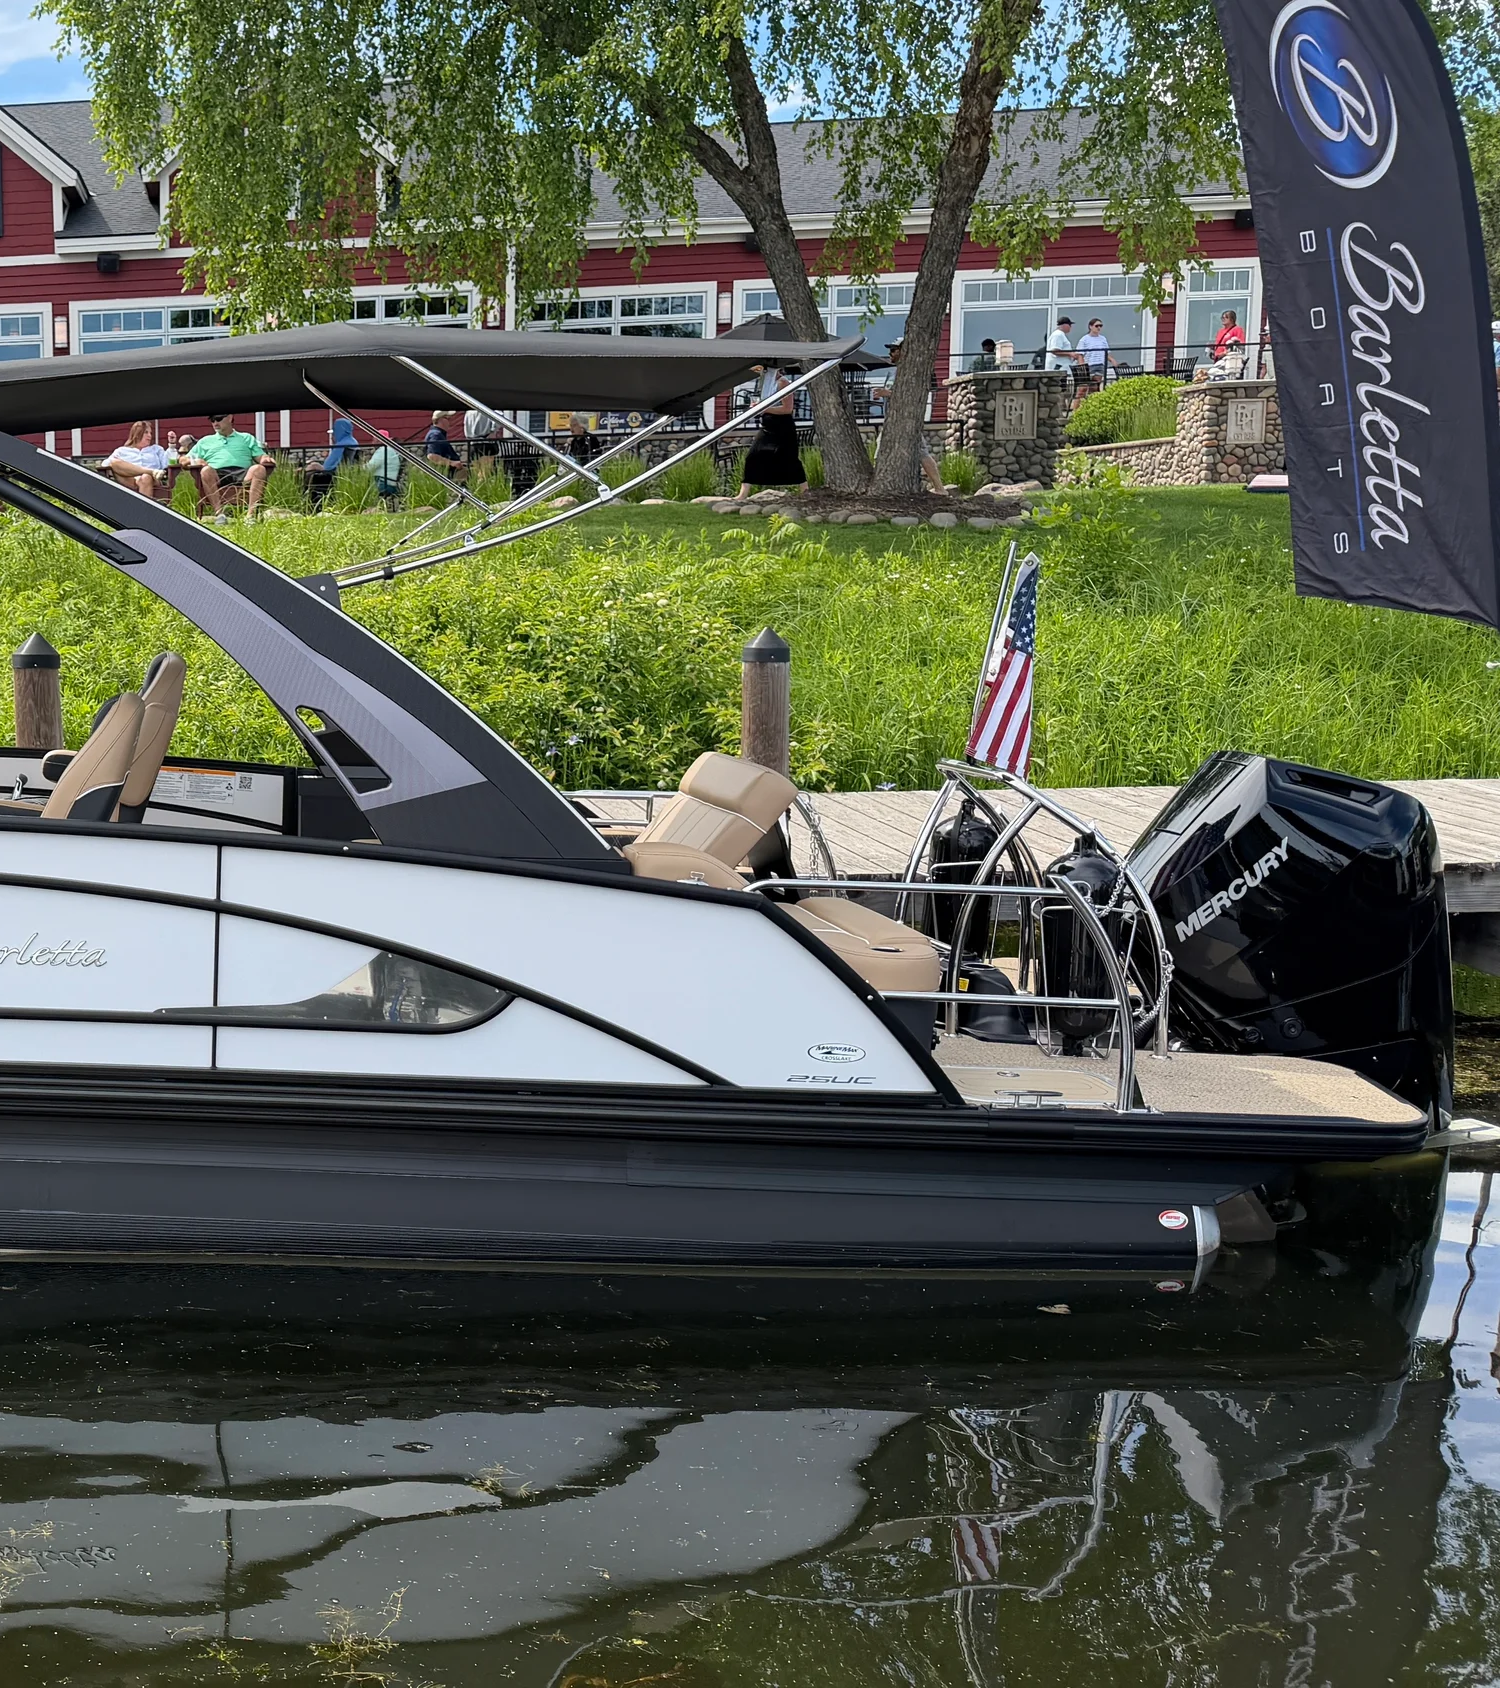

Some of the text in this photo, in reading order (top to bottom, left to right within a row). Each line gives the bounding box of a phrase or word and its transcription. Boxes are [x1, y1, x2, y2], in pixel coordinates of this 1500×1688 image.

[1299, 229, 1350, 555] BOATS
[1339, 220, 1432, 551] Barletta
[1174, 836, 1289, 943] MERCURY
[786, 1074, 877, 1085] 25UC
